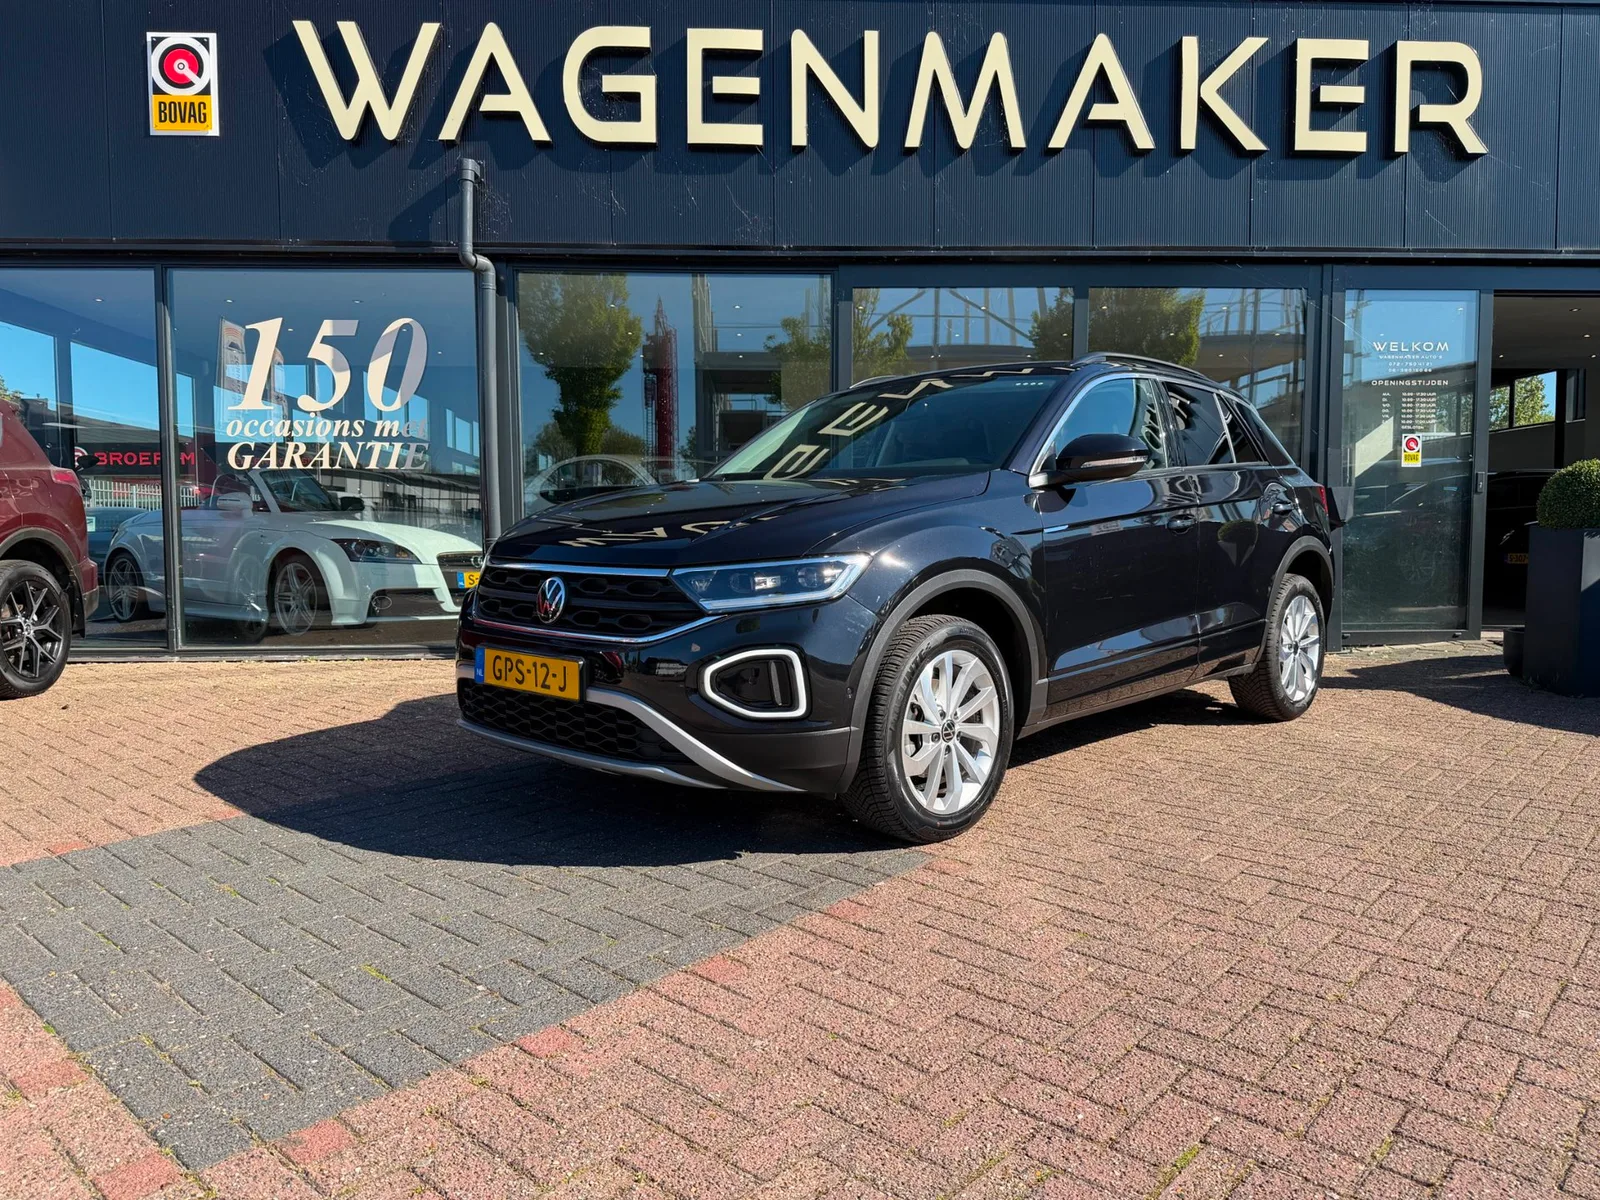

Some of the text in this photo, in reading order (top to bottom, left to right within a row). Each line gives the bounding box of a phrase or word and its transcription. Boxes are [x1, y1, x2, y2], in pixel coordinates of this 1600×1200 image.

[292, 20, 1488, 155] WAGENMAKER
[158, 101, 207, 125] BOVAG
[1373, 341, 1449, 352] WELKOM
[227, 316, 429, 412] 150
[226, 411, 365, 438] occasions
[227, 440, 430, 470] GARANTIE
[1404, 453, 1419, 461] BOVAG
[476, 668, 484, 677] NL
[492, 654, 567, 693] GPS-12-J
